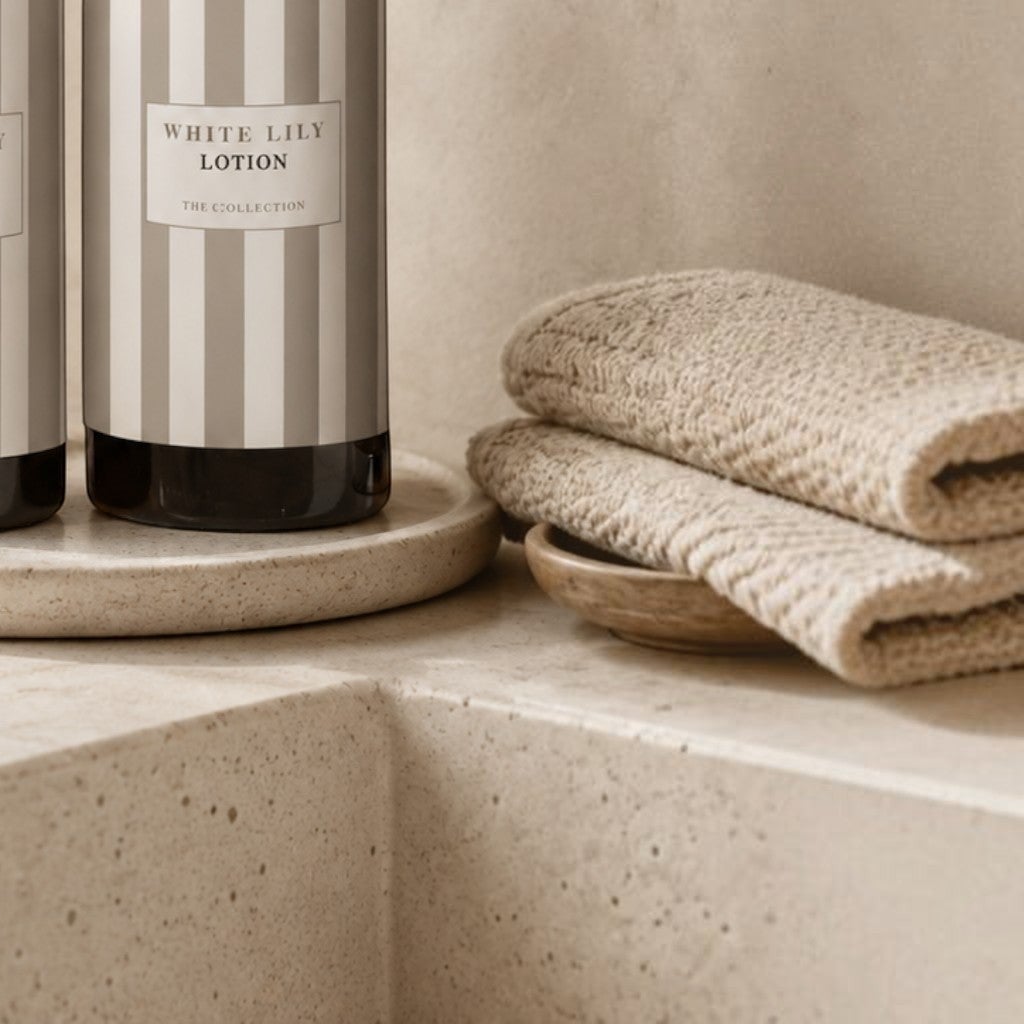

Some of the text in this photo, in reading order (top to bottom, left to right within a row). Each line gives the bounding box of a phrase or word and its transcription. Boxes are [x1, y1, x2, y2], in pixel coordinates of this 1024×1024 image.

[164, 121, 324, 143] WHITE LILY
[200, 153, 288, 171] LOTION
[182, 200, 208, 212] THE
